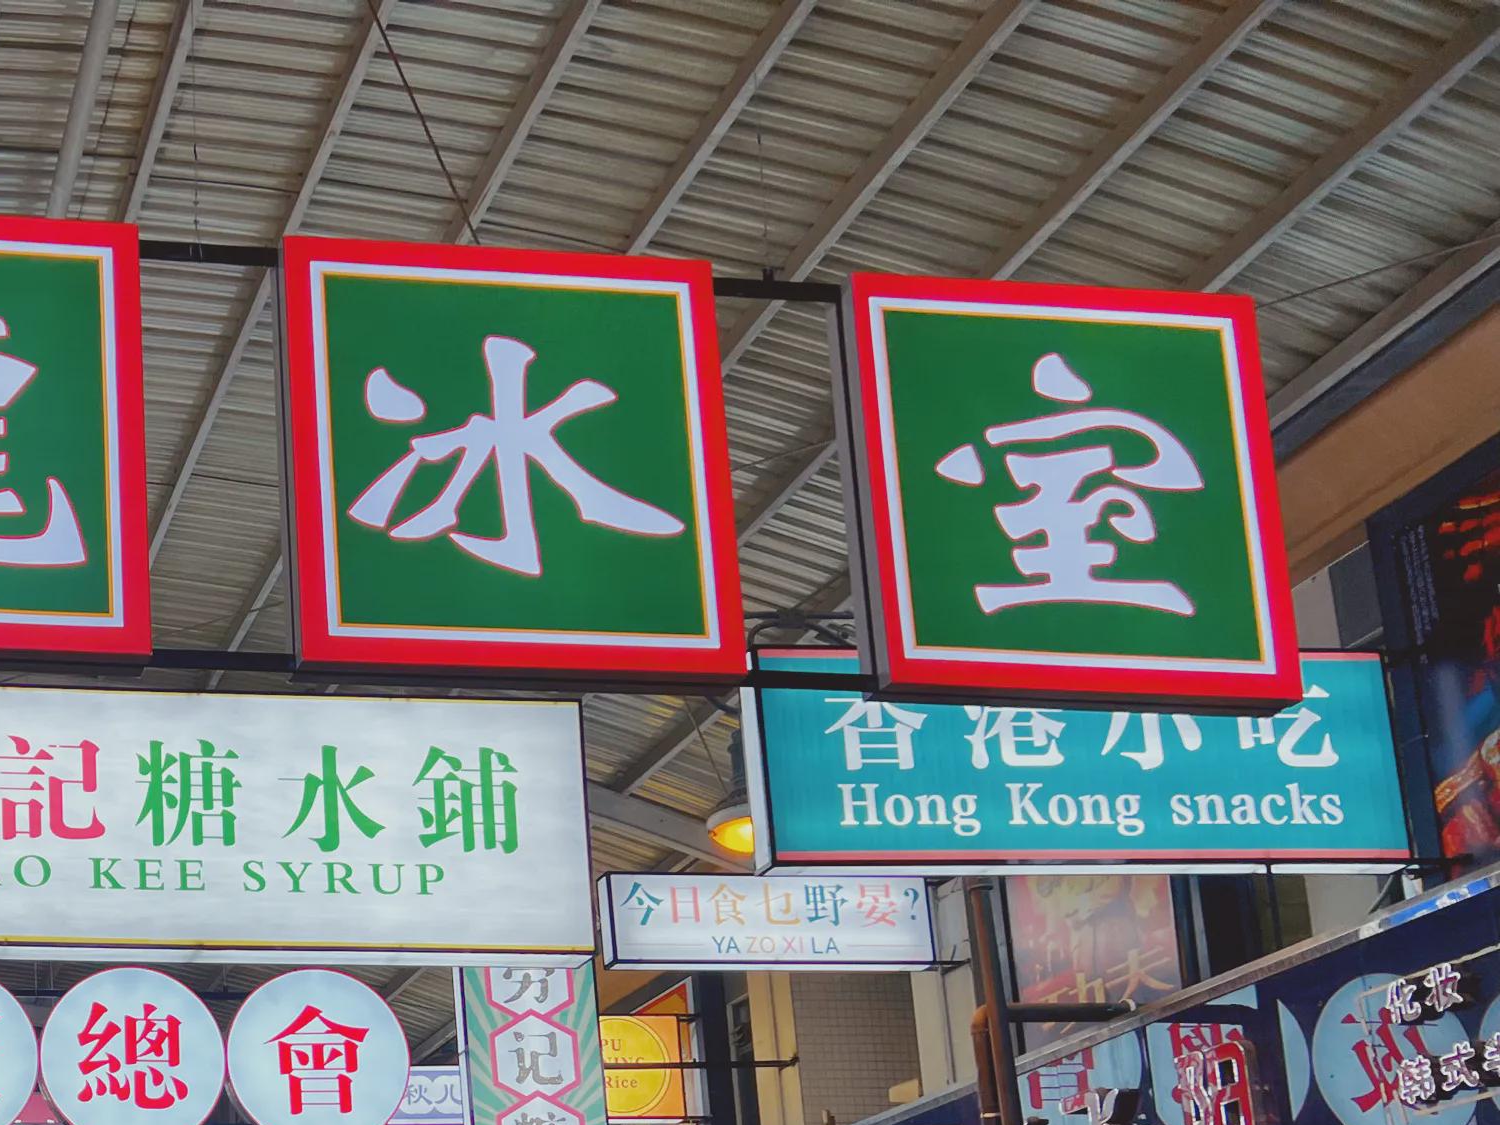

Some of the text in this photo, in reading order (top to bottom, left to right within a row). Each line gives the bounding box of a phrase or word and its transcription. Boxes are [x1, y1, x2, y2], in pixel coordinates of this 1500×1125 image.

[839, 781, 1344, 839] Hong Kong snacks
[88, 856, 206, 893] KEE
[242, 859, 447, 897] SYRUP
